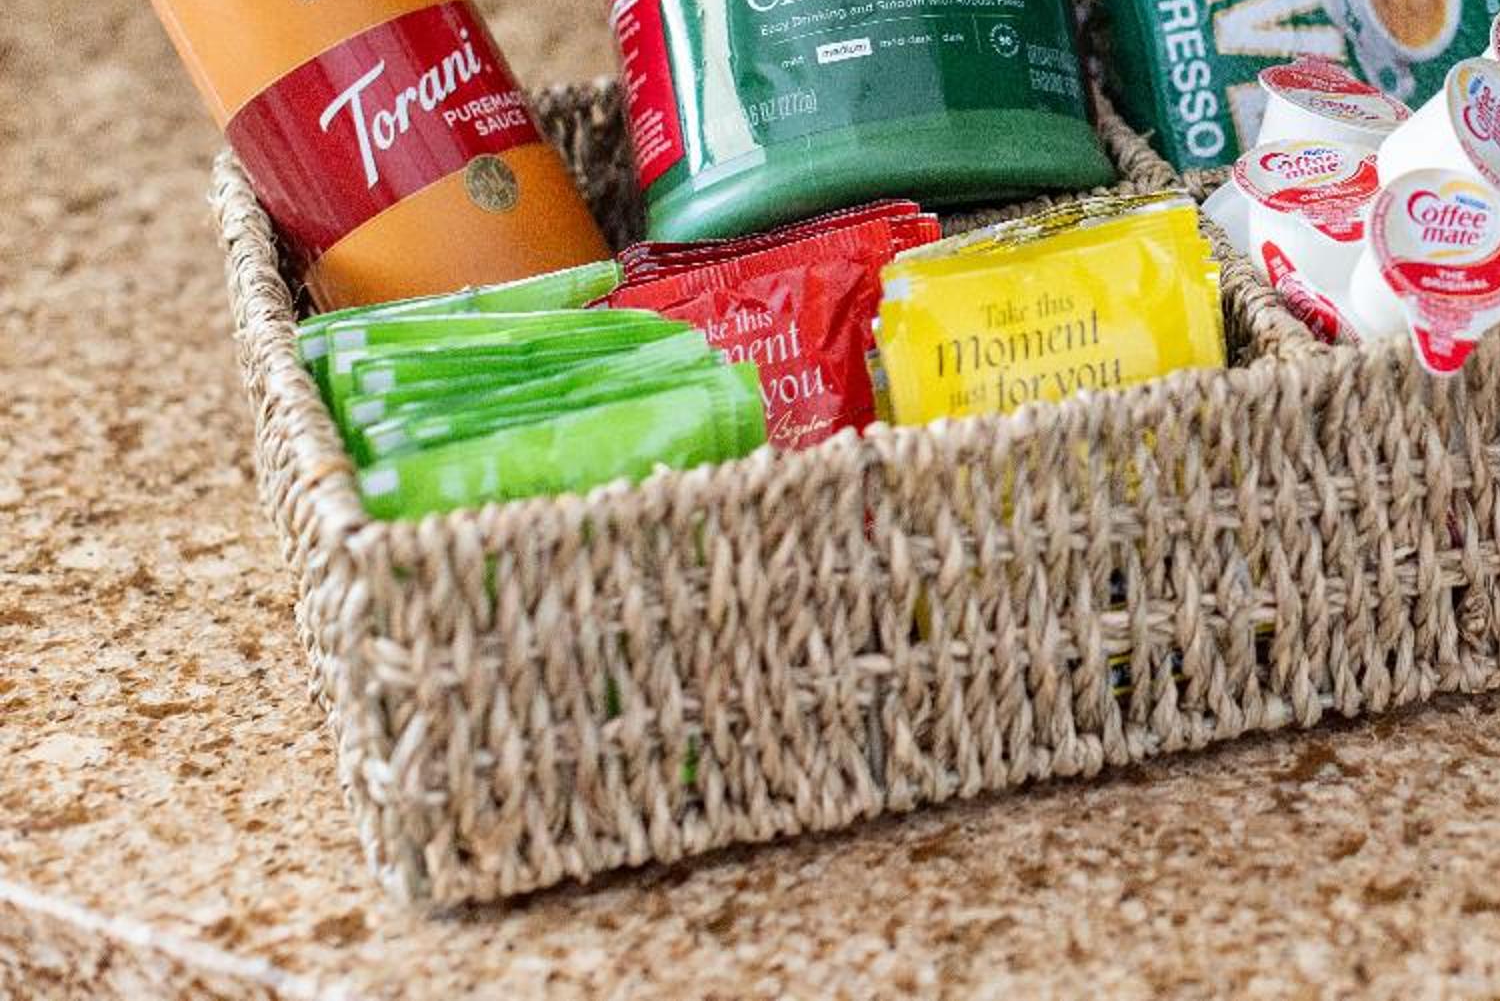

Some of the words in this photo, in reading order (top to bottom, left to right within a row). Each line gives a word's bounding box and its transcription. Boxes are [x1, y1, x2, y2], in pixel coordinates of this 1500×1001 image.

[791, 7, 847, 29] Drinking
[850, 3, 874, 15] and
[319, 27, 482, 190] Torani
[442, 90, 527, 128] PUREMAD
[474, 108, 527, 137] SAUCE
[1407, 189, 1488, 230] Coffee
[1422, 226, 1481, 247] mate
[705, 317, 729, 344] ke
[734, 306, 774, 334] this
[980, 299, 1029, 328] Take
[1036, 291, 1075, 319] this
[759, 364, 834, 420] you.
[995, 365, 1047, 412] for
